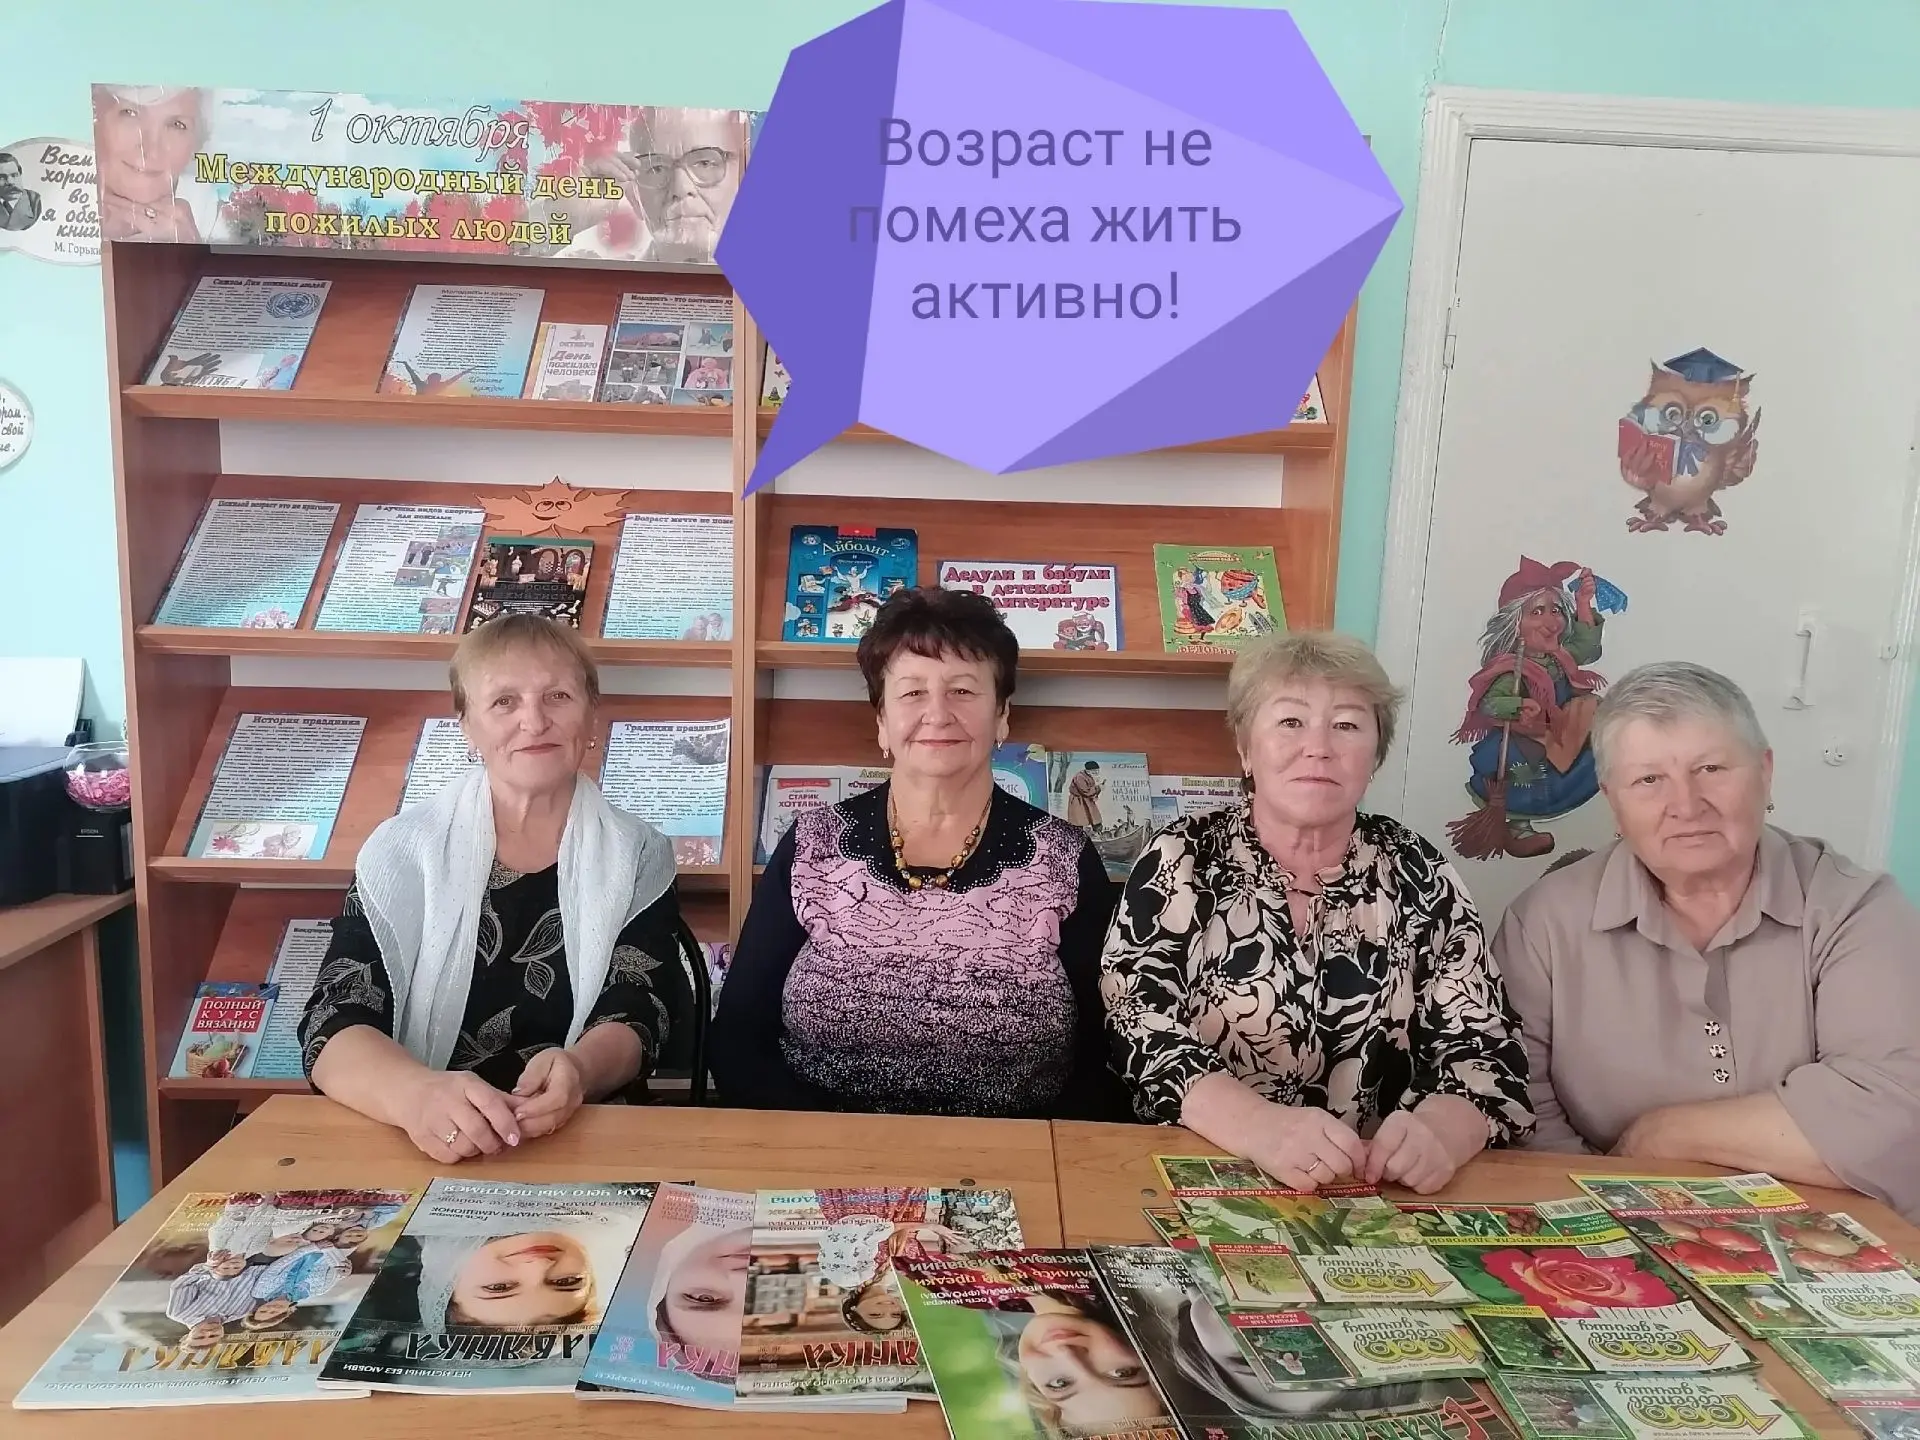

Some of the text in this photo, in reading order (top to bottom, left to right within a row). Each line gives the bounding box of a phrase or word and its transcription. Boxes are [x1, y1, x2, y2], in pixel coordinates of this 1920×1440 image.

[310, 98, 530, 162] 1 октября
[40, 144, 93, 166] Всем
[41, 167, 97, 189] хорош
[195, 152, 625, 201] Международный день
[68, 188, 89, 204] во
[41, 204, 100, 225] я обя
[264, 211, 573, 247] пожилых людей
[551, 350, 593, 362] День
[548, 360, 599, 371] пожилого
[545, 368, 598, 377] человека
[634, 513, 669, 525] Возраст
[711, 517, 734, 526] поме
[822, 539, 890, 556] Айболит
[943, 563, 1112, 584] Дедули и бабули
[972, 580, 1073, 598] в детской
[992, 595, 1111, 613] литературе
[251, 715, 300, 726] История
[624, 722, 674, 734] Традиции
[788, 793, 821, 801] СТАРИК
[778, 800, 829, 809] ХОТТАБЫЧ
[203, 1000, 262, 1011] ПОЛНЫЙ
[200, 1010, 260, 1020] КУРС
[196, 1020, 257, 1030] ВЯЗАНИЯ
[442, 1185, 533, 1197] постимся
[538, 1188, 566, 1198] мы
[573, 1187, 611, 1198] чего
[1177, 1189, 1225, 1197] ТЕСНОТЫ
[1225, 1189, 1263, 1197] ЛЮБЯТ
[1263, 1189, 1278, 1197] НЕ
[1018, 1253, 1090, 1265] енском
[1317, 1257, 1384, 1269] дачнику
[1030, 1268, 1092, 1280] олились
[1325, 1266, 1408, 1277] советов
[913, 1273, 976, 1287] предки
[1342, 1316, 1416, 1332] дачнику
[1577, 1320, 1651, 1334] дачнику
[1354, 1329, 1440, 1344] советов
[1590, 1331, 1675, 1343] советов
[802, 1340, 920, 1371] ЯНКА
[342, 1363, 472, 1379] НЕТ ИСТИНЫ БЕЗ ЛЮБВИ
[1614, 1381, 1694, 1397] дачнику
[1628, 1395, 1724, 1409] советов
